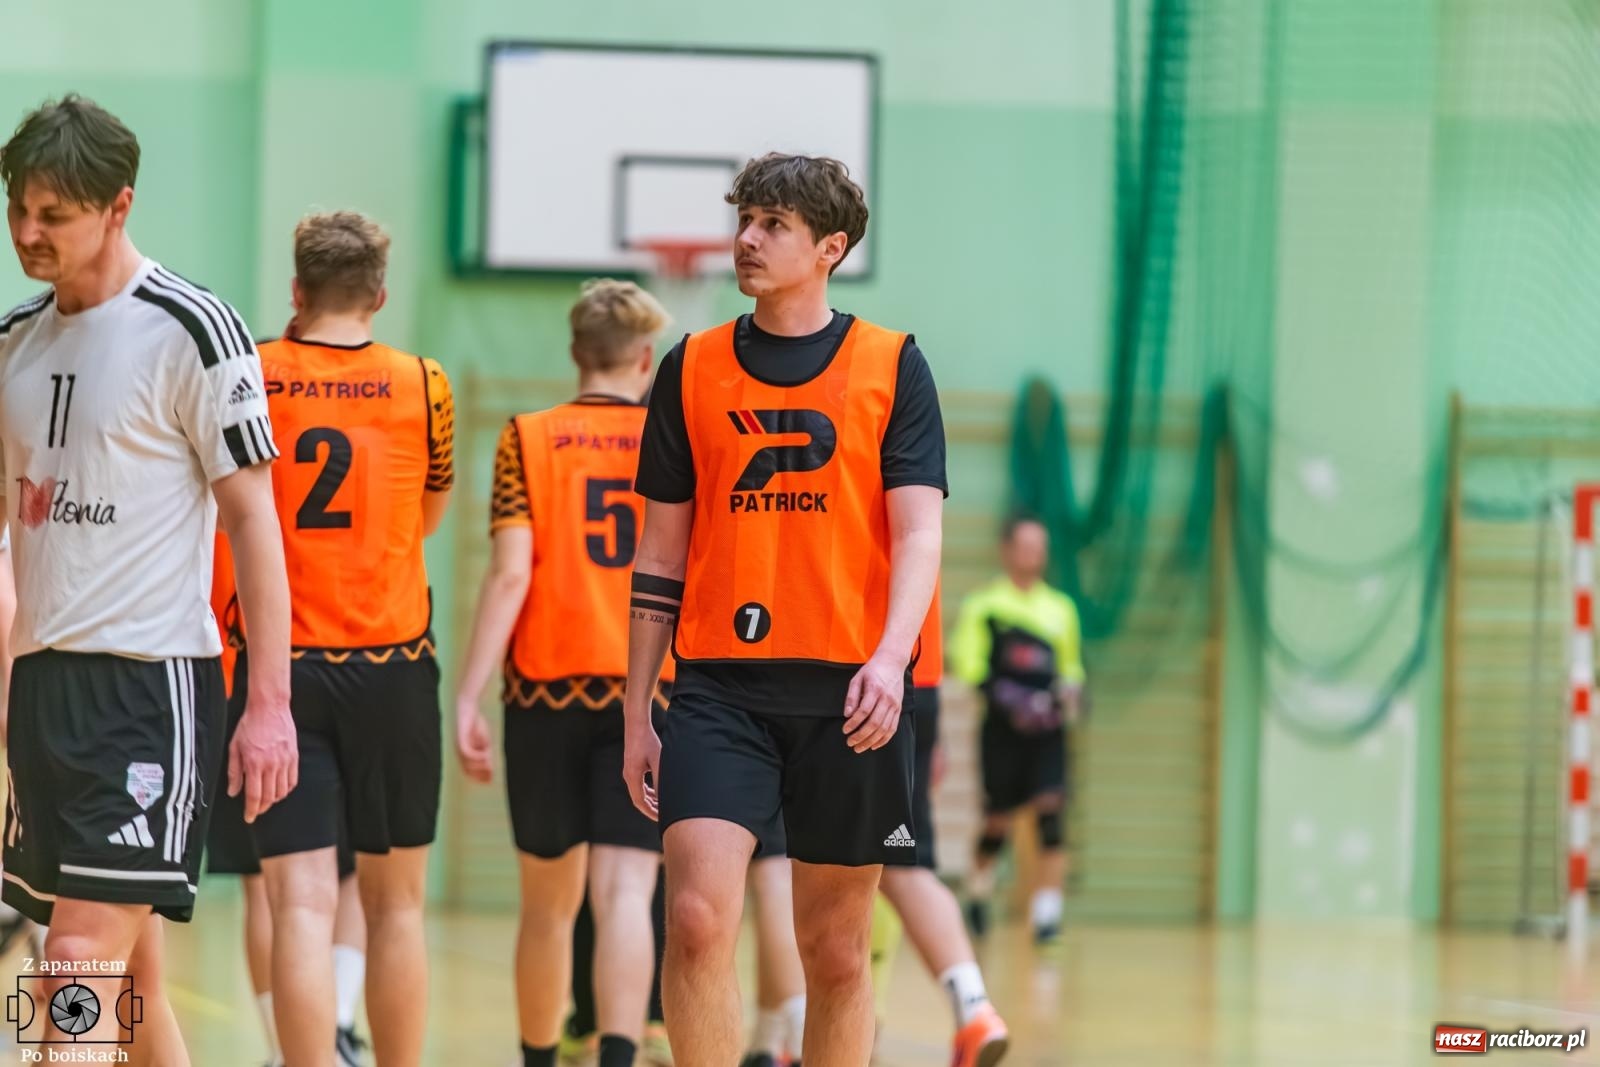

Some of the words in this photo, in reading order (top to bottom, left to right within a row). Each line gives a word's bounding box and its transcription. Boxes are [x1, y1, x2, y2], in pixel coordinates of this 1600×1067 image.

[289, 380, 392, 398] PATRICK
[48, 373, 76, 449] 11
[577, 434, 639, 451] PATRI
[295, 427, 353, 529] 2
[729, 491, 828, 513] PATRICK
[586, 477, 636, 568] 5
[745, 608, 761, 640] 7
[883, 838, 916, 847] adidas
